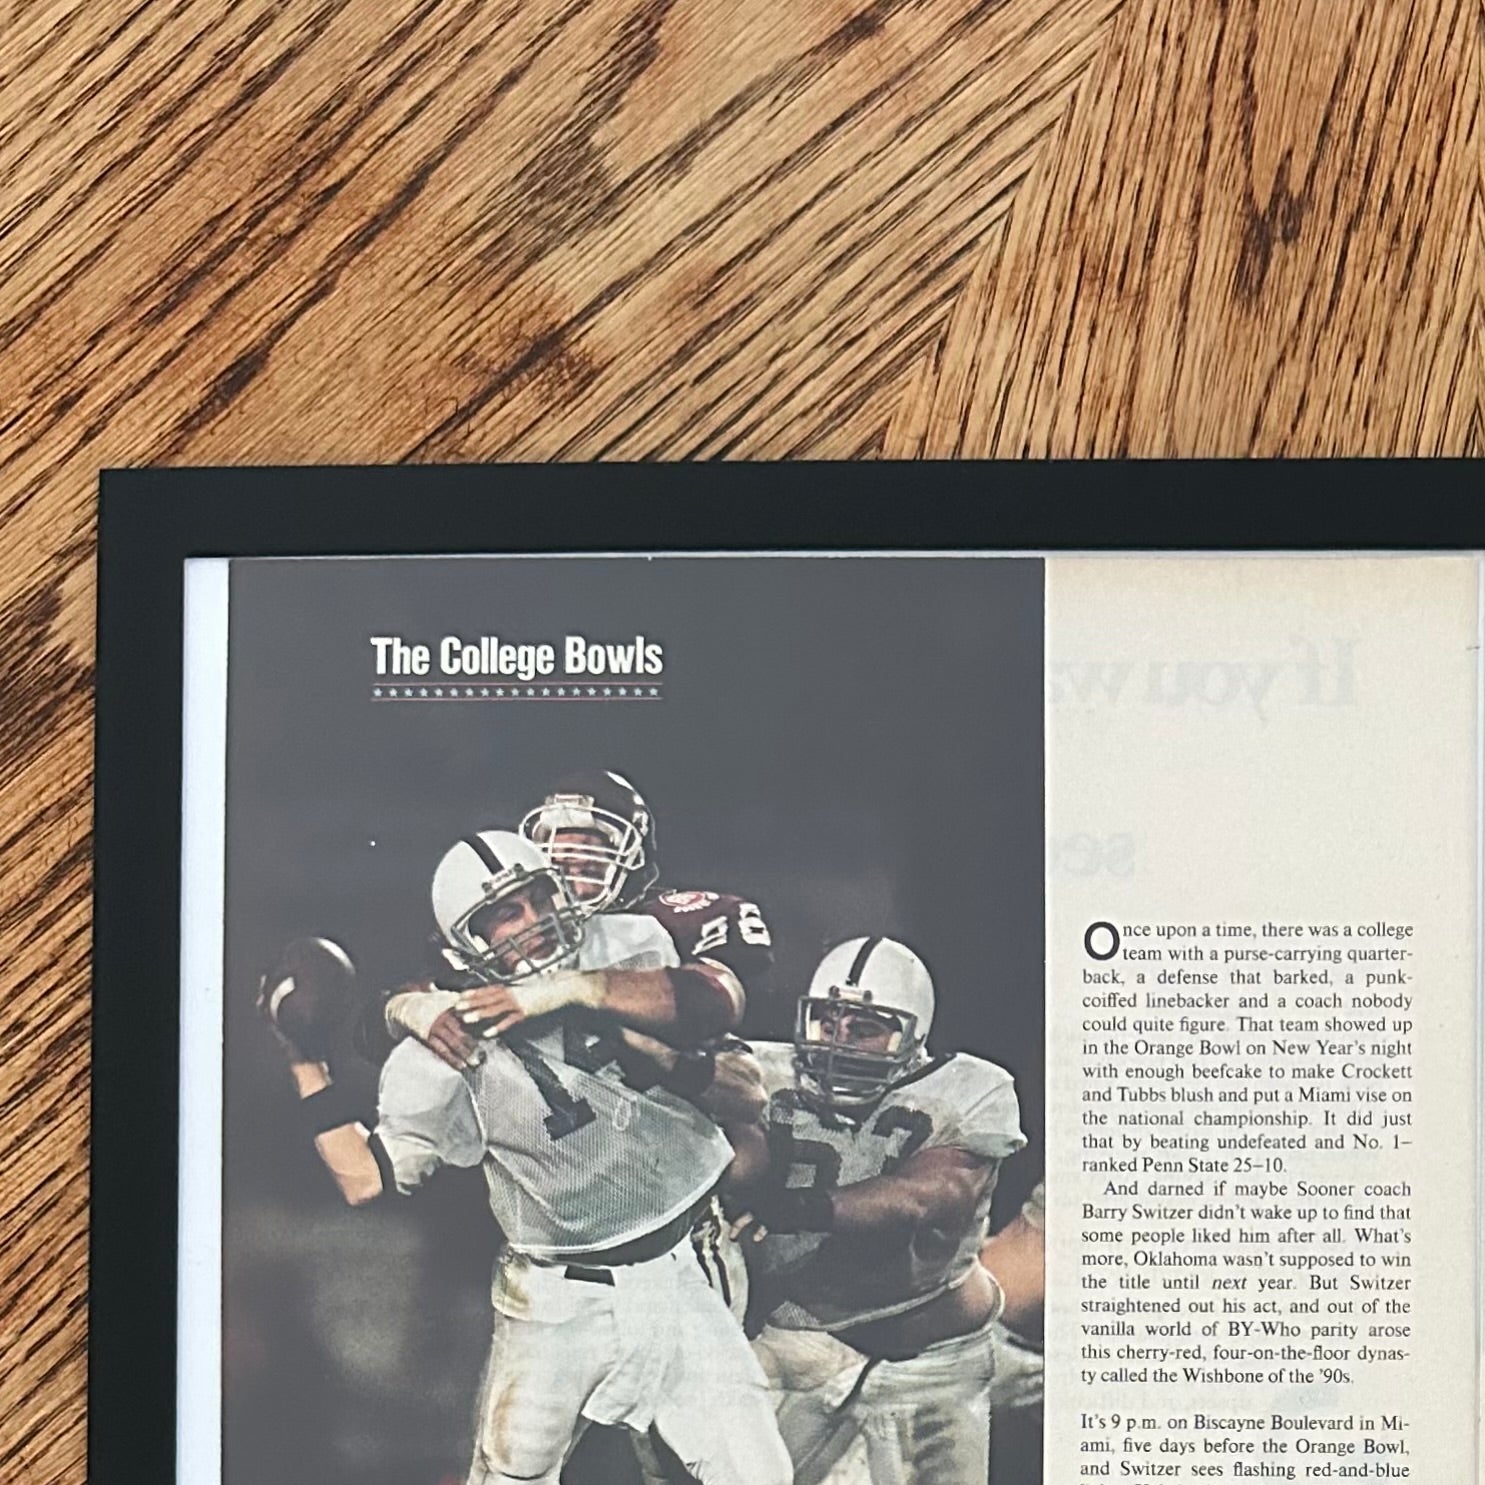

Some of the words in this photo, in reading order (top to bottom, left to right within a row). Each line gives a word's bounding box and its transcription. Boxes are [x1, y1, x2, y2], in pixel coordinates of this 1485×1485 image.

[370, 637, 429, 675] The
[441, 637, 554, 680] College
[565, 636, 662, 674] Bowls
[1084, 921, 1151, 961] Once
[1156, 926, 1196, 940] upon
[1201, 926, 1212, 937] a
[1216, 921, 1257, 940] time,
[1262, 922, 1303, 937] there
[1308, 926, 1339, 937] was
[1342, 926, 1353, 937] a
[1357, 921, 1413, 940] college
[1082, 992, 1137, 1008] coiffed
[1146, 992, 1230, 1008] linebacker
[1239, 993, 1268, 1008] and
[1276, 997, 1287, 1008] a
[1295, 992, 1342, 1008] coach
[1352, 992, 1412, 1011] nobody
[1082, 1110, 1108, 1126] the
[1119, 1110, 1184, 1126] national
[1194, 1110, 1312, 1129] championship.
[1323, 1110, 1337, 1126] It
[1347, 1110, 1372, 1126] did
[1381, 1110, 1412, 1129] just
[1081, 1320, 1135, 1336] vanilla
[1145, 1321, 1191, 1337] world
[1202, 1321, 1220, 1337] of
[1228, 1321, 1301, 1337] BY-Who
[1310, 1321, 1358, 1340] parity
[1368, 1326, 1411, 1338] arose
